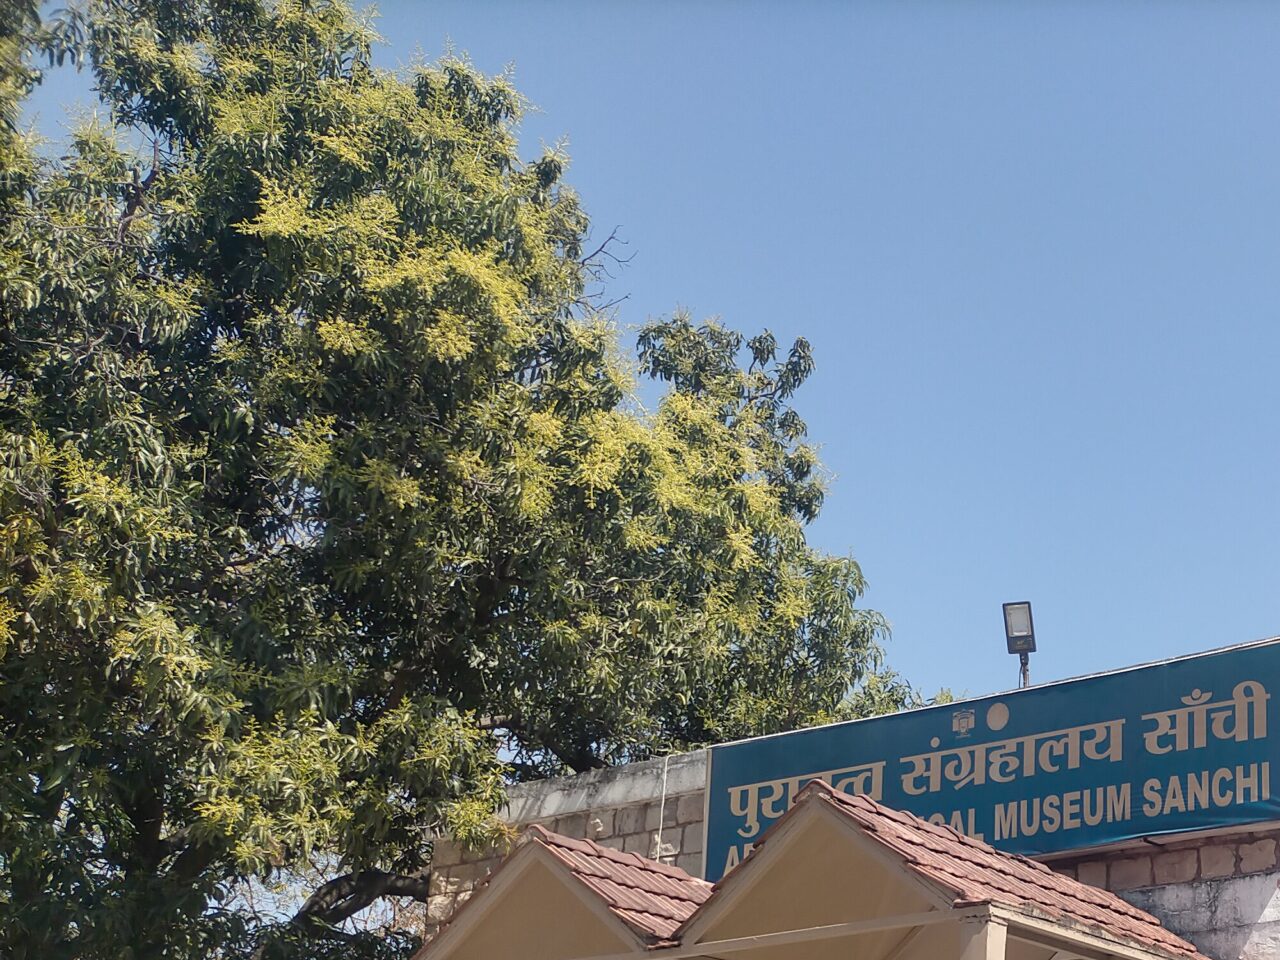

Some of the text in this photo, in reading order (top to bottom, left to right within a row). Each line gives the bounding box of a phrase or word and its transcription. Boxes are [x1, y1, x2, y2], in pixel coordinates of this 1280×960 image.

[727, 680, 1271, 838] पुरात्व संग्रहालय साँची
[994, 762, 1271, 841] MUSEUM SANCHI
